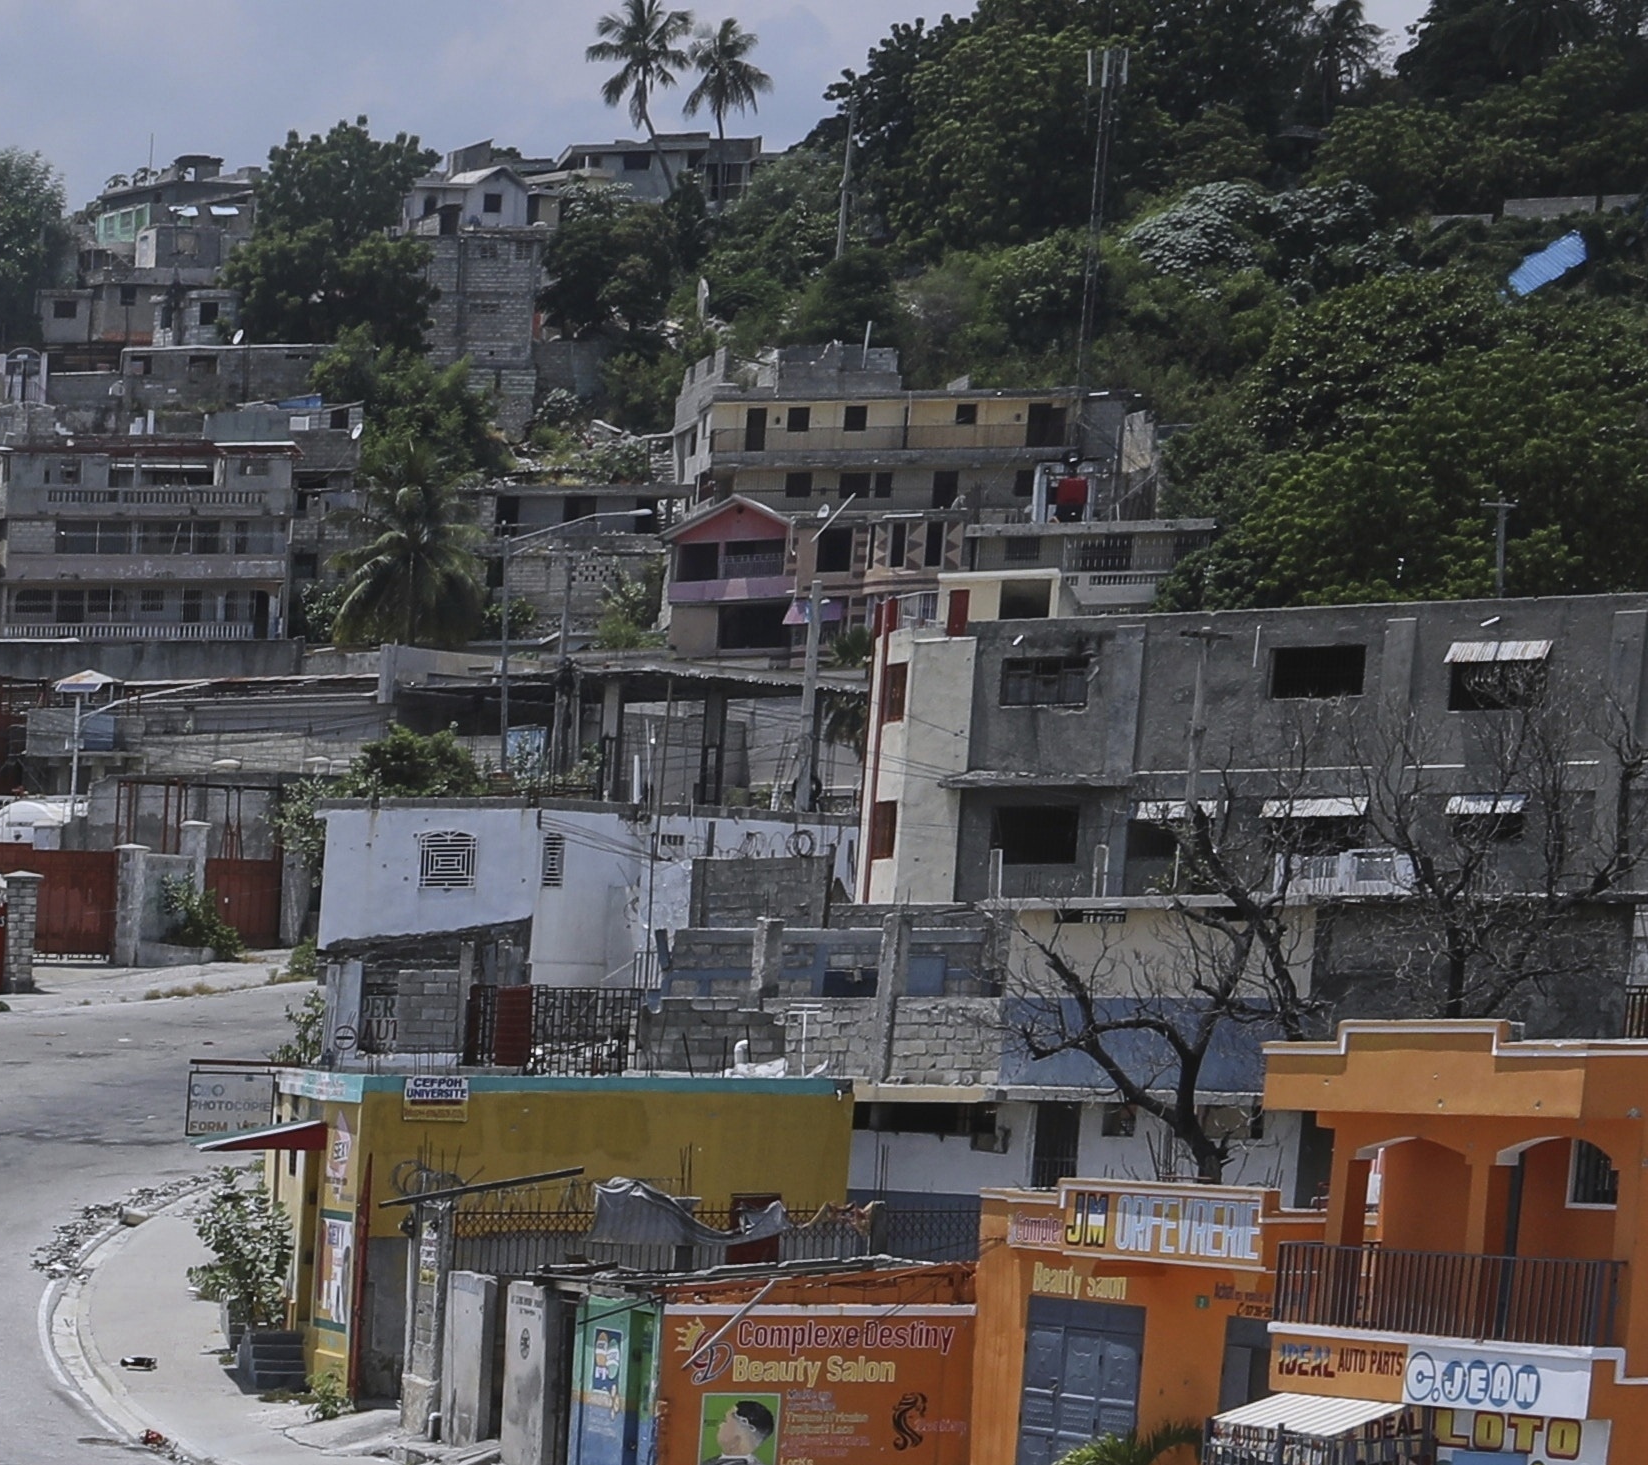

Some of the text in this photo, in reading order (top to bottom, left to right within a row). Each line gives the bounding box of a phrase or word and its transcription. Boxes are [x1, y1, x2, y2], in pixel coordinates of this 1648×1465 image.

[191, 1083, 225, 1097] CO
[406, 1088, 467, 1099] UNIVERSITE
[413, 1077, 463, 1088] CEFPOH
[190, 1100, 272, 1112] PHOTOCOPIE
[189, 1121, 228, 1132] FORM
[1065, 1192, 1261, 1260] JM ORFEVRERIE
[1033, 1261, 1082, 1299] Beauty
[737, 1319, 956, 1356] Complexe Destiny
[732, 1354, 896, 1388] Beauty Salon
[1278, 1343, 1404, 1379] IDEAL AUTO PARTS
[1433, 1408, 1583, 1460] LOTO
